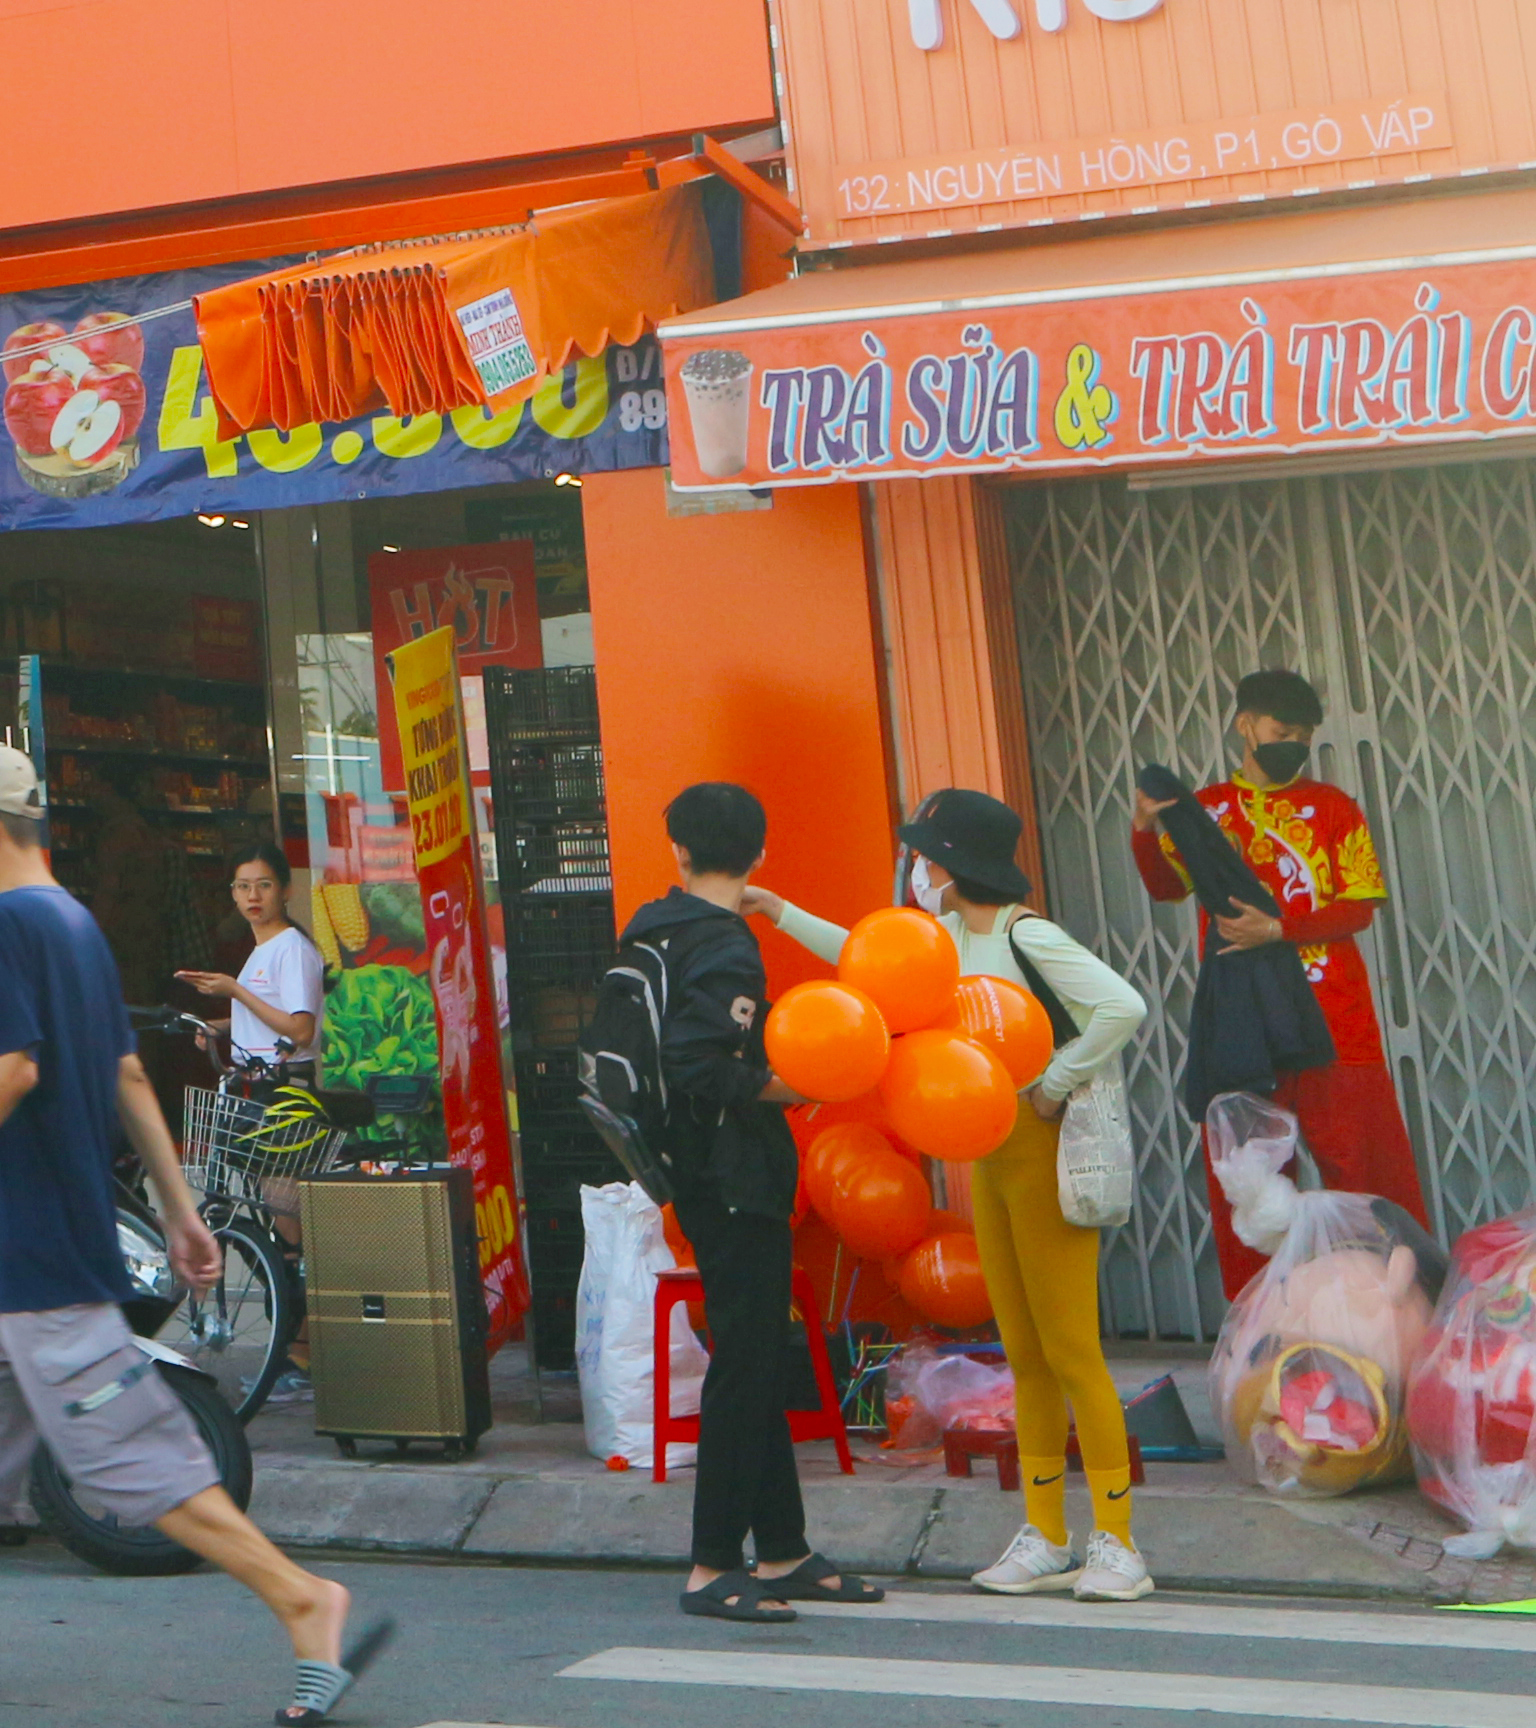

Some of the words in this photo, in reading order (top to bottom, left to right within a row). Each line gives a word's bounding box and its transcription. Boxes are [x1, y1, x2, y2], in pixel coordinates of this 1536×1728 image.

[1282, 113, 1343, 160] GÒ
[1360, 99, 1436, 156] VẤP
[760, 332, 893, 474] TRÀ
[898, 326, 1040, 462] SỮA
[1054, 343, 1118, 450] &
[1129, 296, 1277, 446] TRÀ
[1286, 281, 1472, 436] TRÁI
[390, 560, 515, 647] HOT
